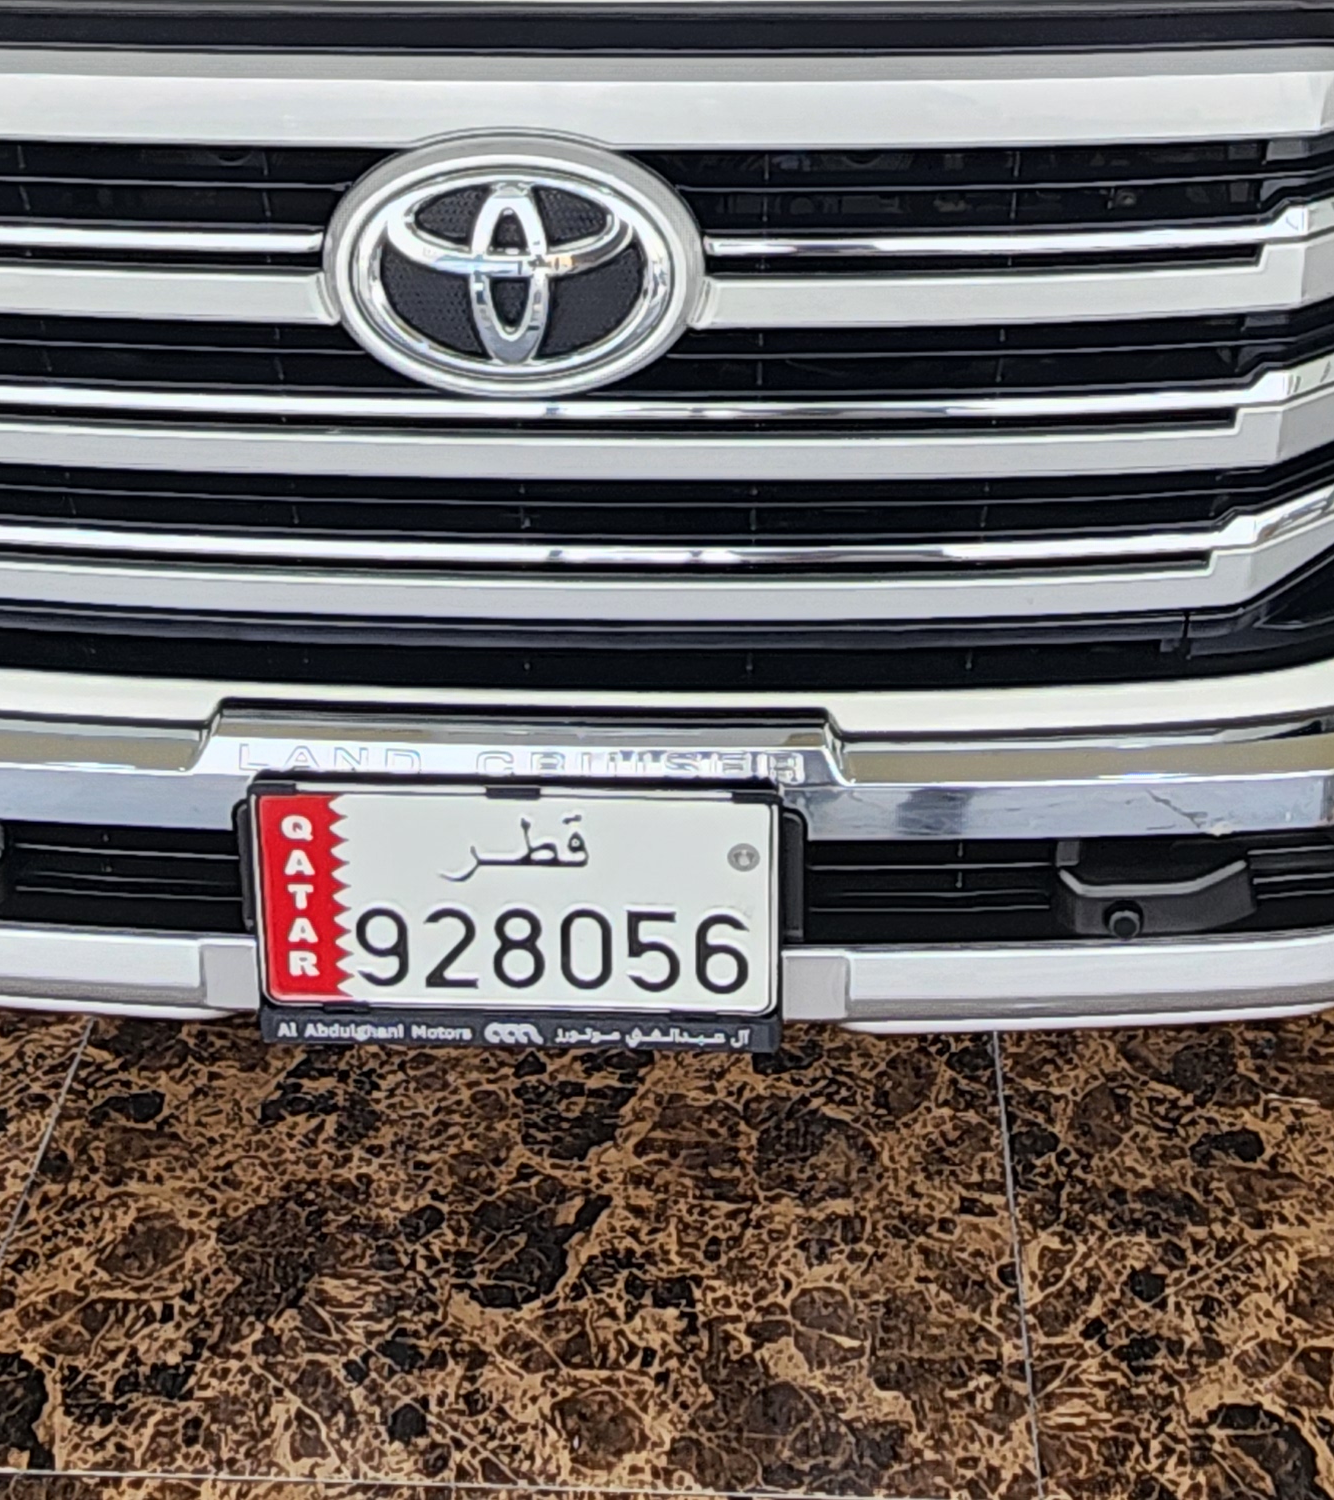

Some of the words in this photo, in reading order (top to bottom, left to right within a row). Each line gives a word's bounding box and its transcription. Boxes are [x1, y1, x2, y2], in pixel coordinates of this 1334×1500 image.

[238, 743, 422, 772] LAND
[437, 813, 590, 883] قطر
[279, 814, 321, 978] QATAR
[354, 904, 750, 995] 928056
[278, 1022, 298, 1038] Al
[304, 1022, 404, 1042] Abdulghani
[411, 1023, 473, 1040] Motors
